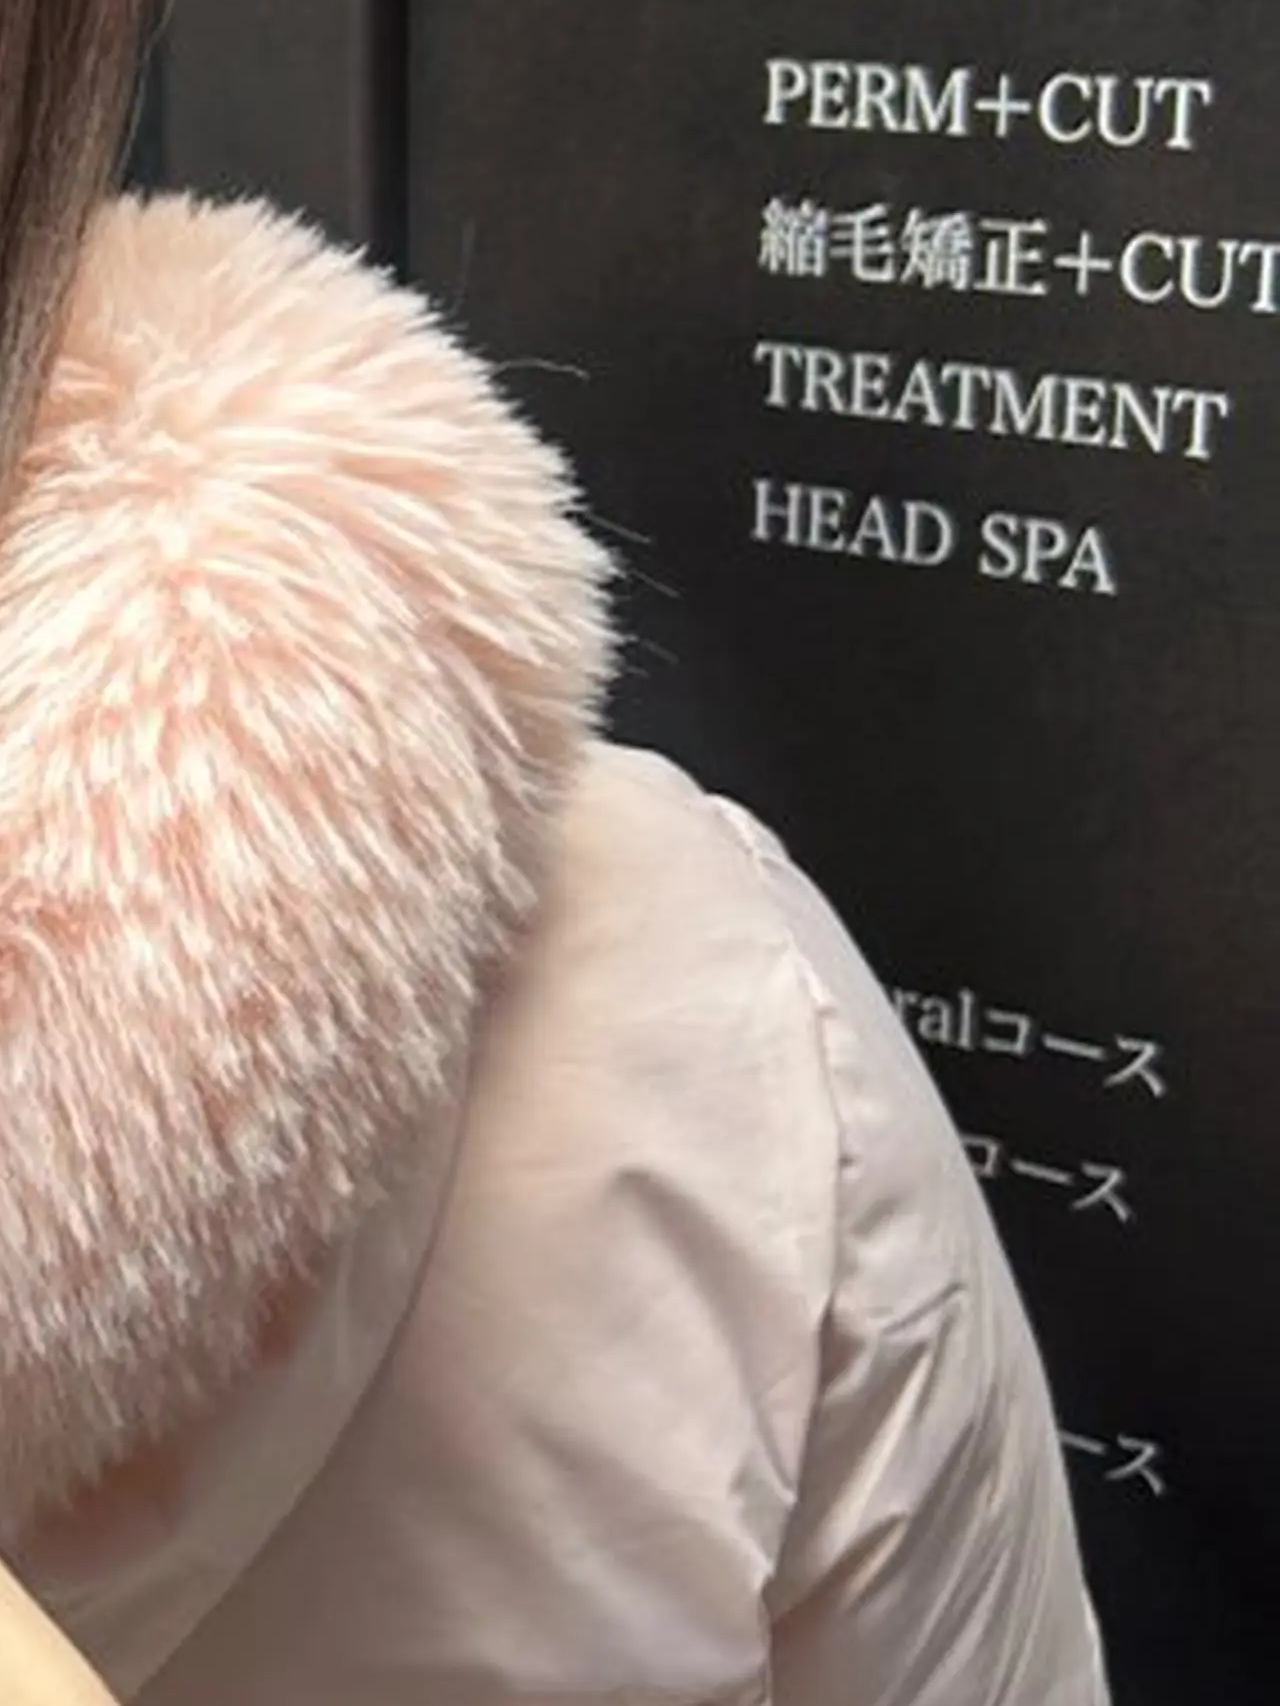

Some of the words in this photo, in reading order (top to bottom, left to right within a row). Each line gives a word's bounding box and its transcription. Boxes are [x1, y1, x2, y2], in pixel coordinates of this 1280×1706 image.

[763, 58, 1213, 151] PERM+CUT
[753, 341, 1231, 461] TREATMENT
[752, 478, 955, 566] HEAD
[979, 512, 1117, 596] SPA
